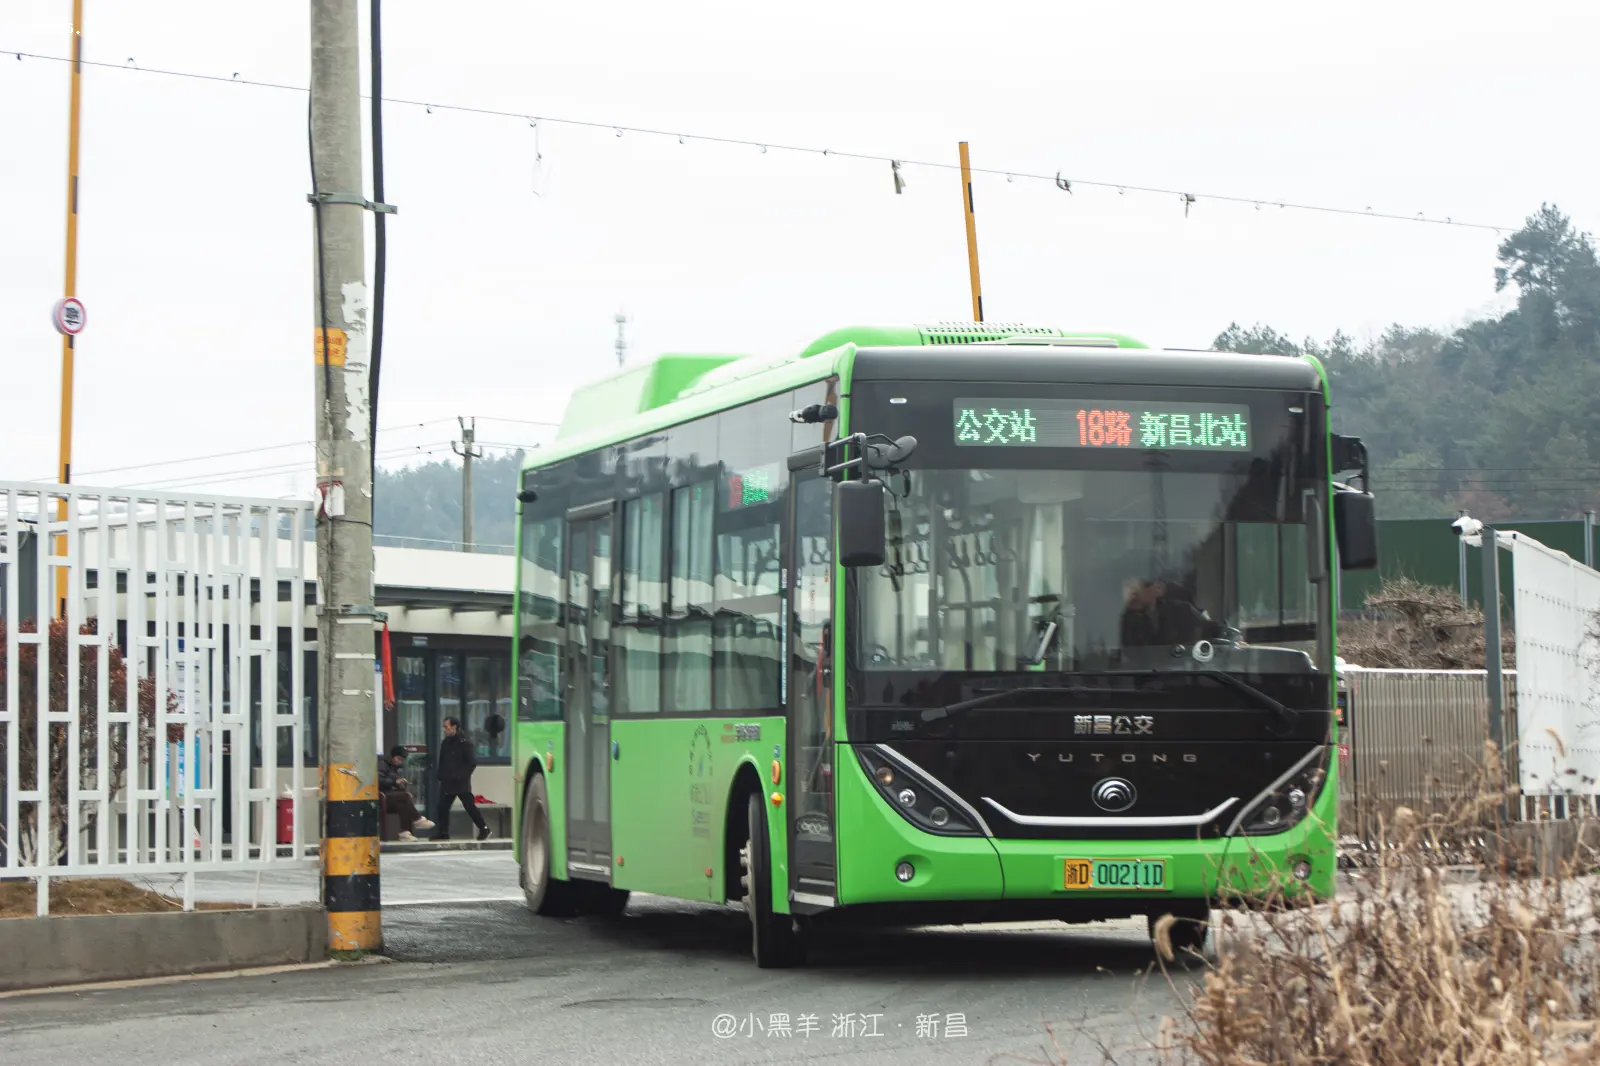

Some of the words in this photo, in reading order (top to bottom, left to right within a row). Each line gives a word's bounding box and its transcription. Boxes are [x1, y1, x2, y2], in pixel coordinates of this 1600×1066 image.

[956, 408, 1036, 444] 公交站
[1076, 409, 1132, 446] 18路
[1139, 412, 1248, 447] 新昌北站
[1073, 714, 1154, 735] 新昌公交
[1027, 753, 1198, 763] YUTONG
